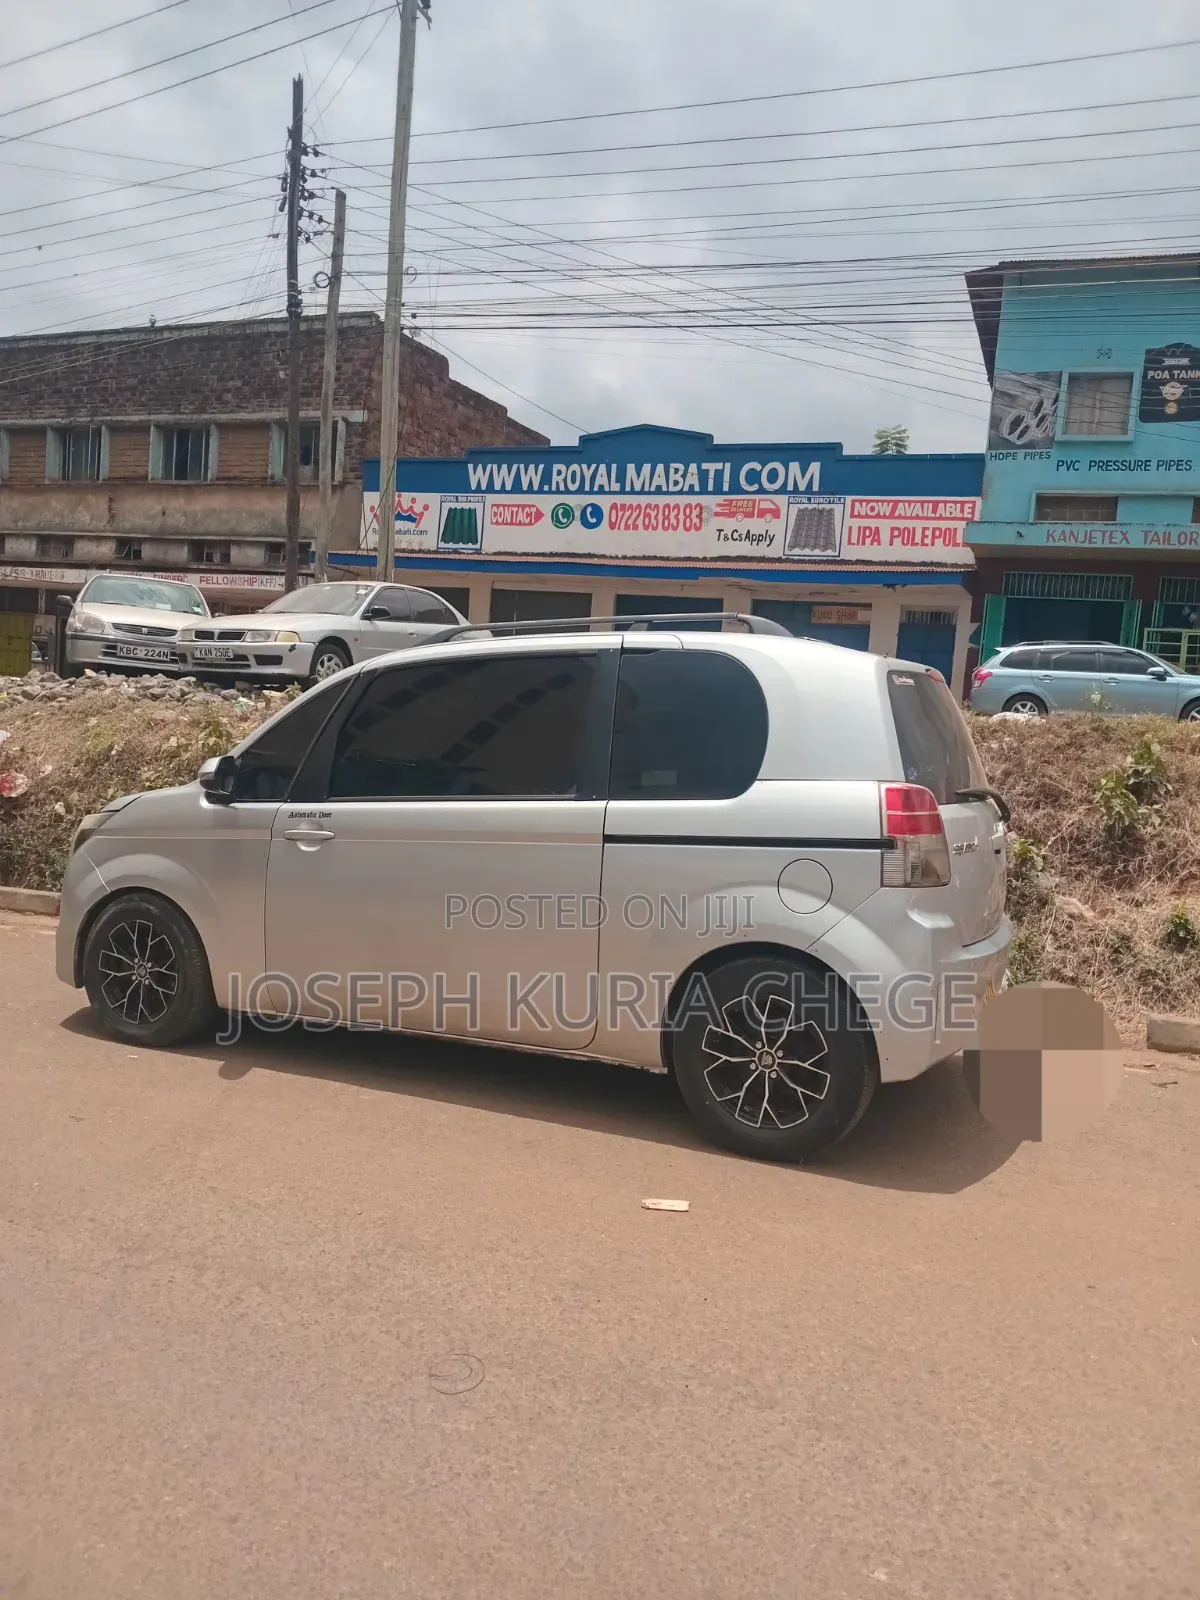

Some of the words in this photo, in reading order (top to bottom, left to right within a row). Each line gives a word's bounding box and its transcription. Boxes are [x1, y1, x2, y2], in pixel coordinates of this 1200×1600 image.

[1147, 370, 1170, 379] POA
[1023, 451, 1052, 460] PIPES
[1056, 459, 1081, 472] PVC
[1088, 459, 1151, 472] PRESSURE
[731, 500, 753, 508] FREE
[853, 502, 894, 516] NOW
[894, 503, 973, 518] AVAILABLE
[491, 506, 537, 524] CONTACT
[744, 529, 776, 547] Apply
[847, 525, 882, 546] LIPA
[1045, 529, 1131, 545] KANJETEX
[1141, 530, 1200, 546] TAILOR
[119, 646, 139, 656] KBC
[143, 648, 170, 660] 224N
[200, 647, 212, 657] KAN
[287, 811, 317, 819] Automatic
[318, 811, 333, 819] Door
